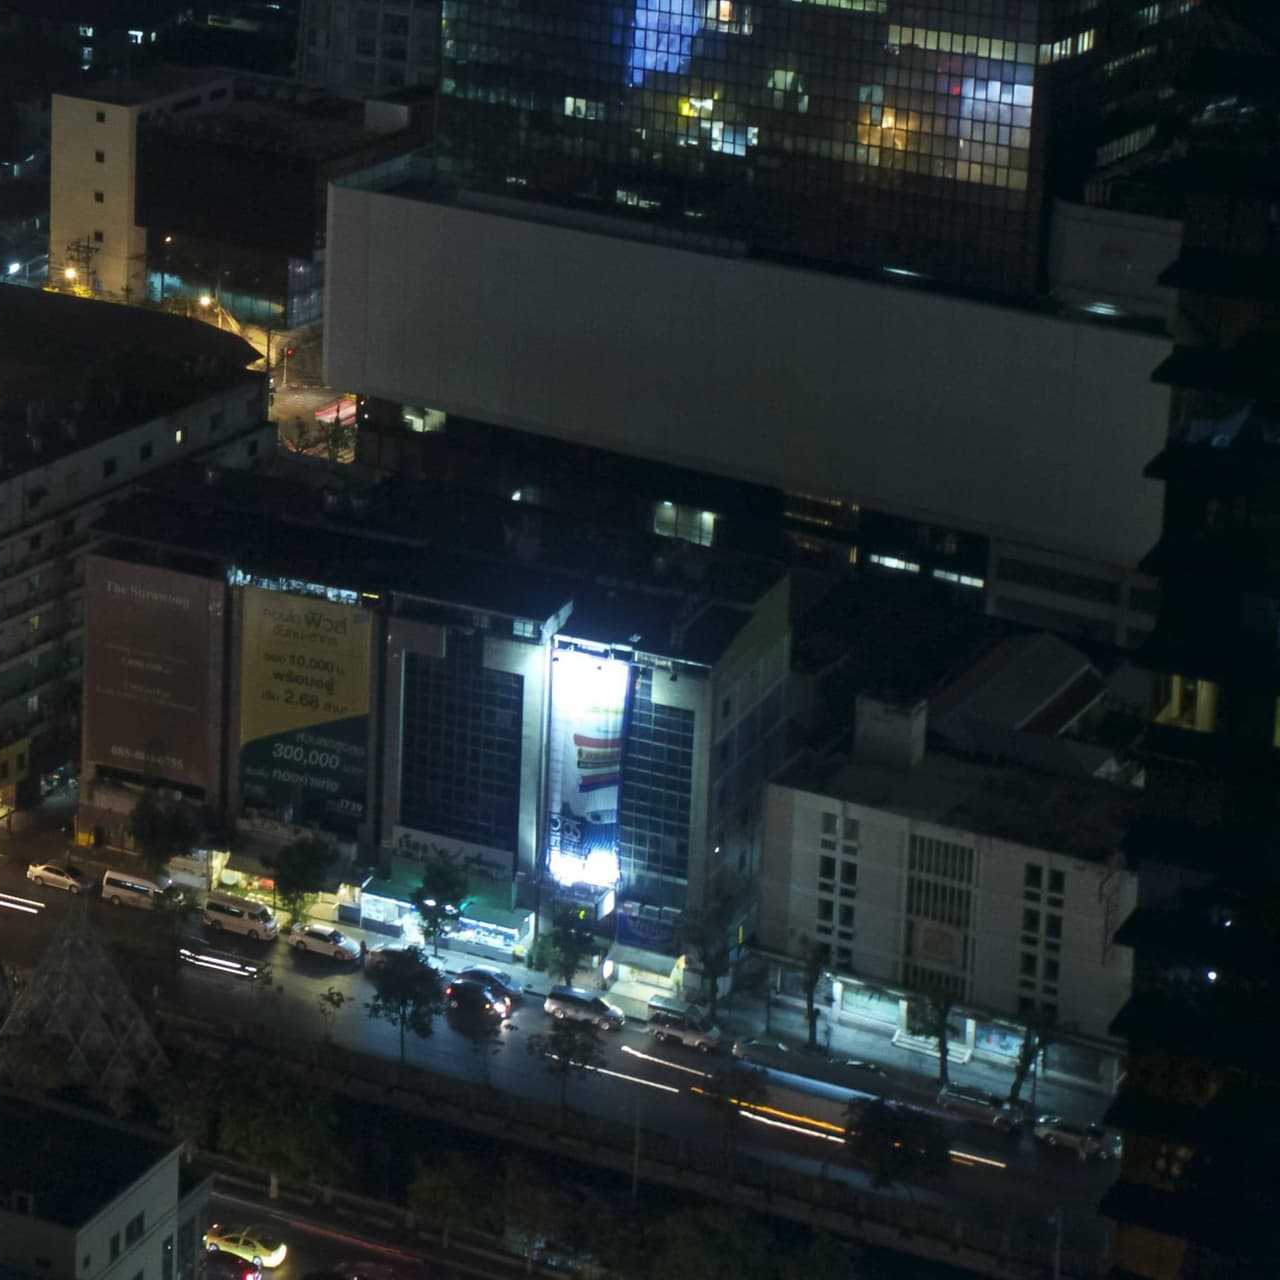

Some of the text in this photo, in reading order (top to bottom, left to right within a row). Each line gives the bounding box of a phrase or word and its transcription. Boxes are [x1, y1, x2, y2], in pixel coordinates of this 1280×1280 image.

[106, 580, 127, 595] The
[289, 654, 334, 673] 10,000
[272, 741, 340, 768] 300,000
